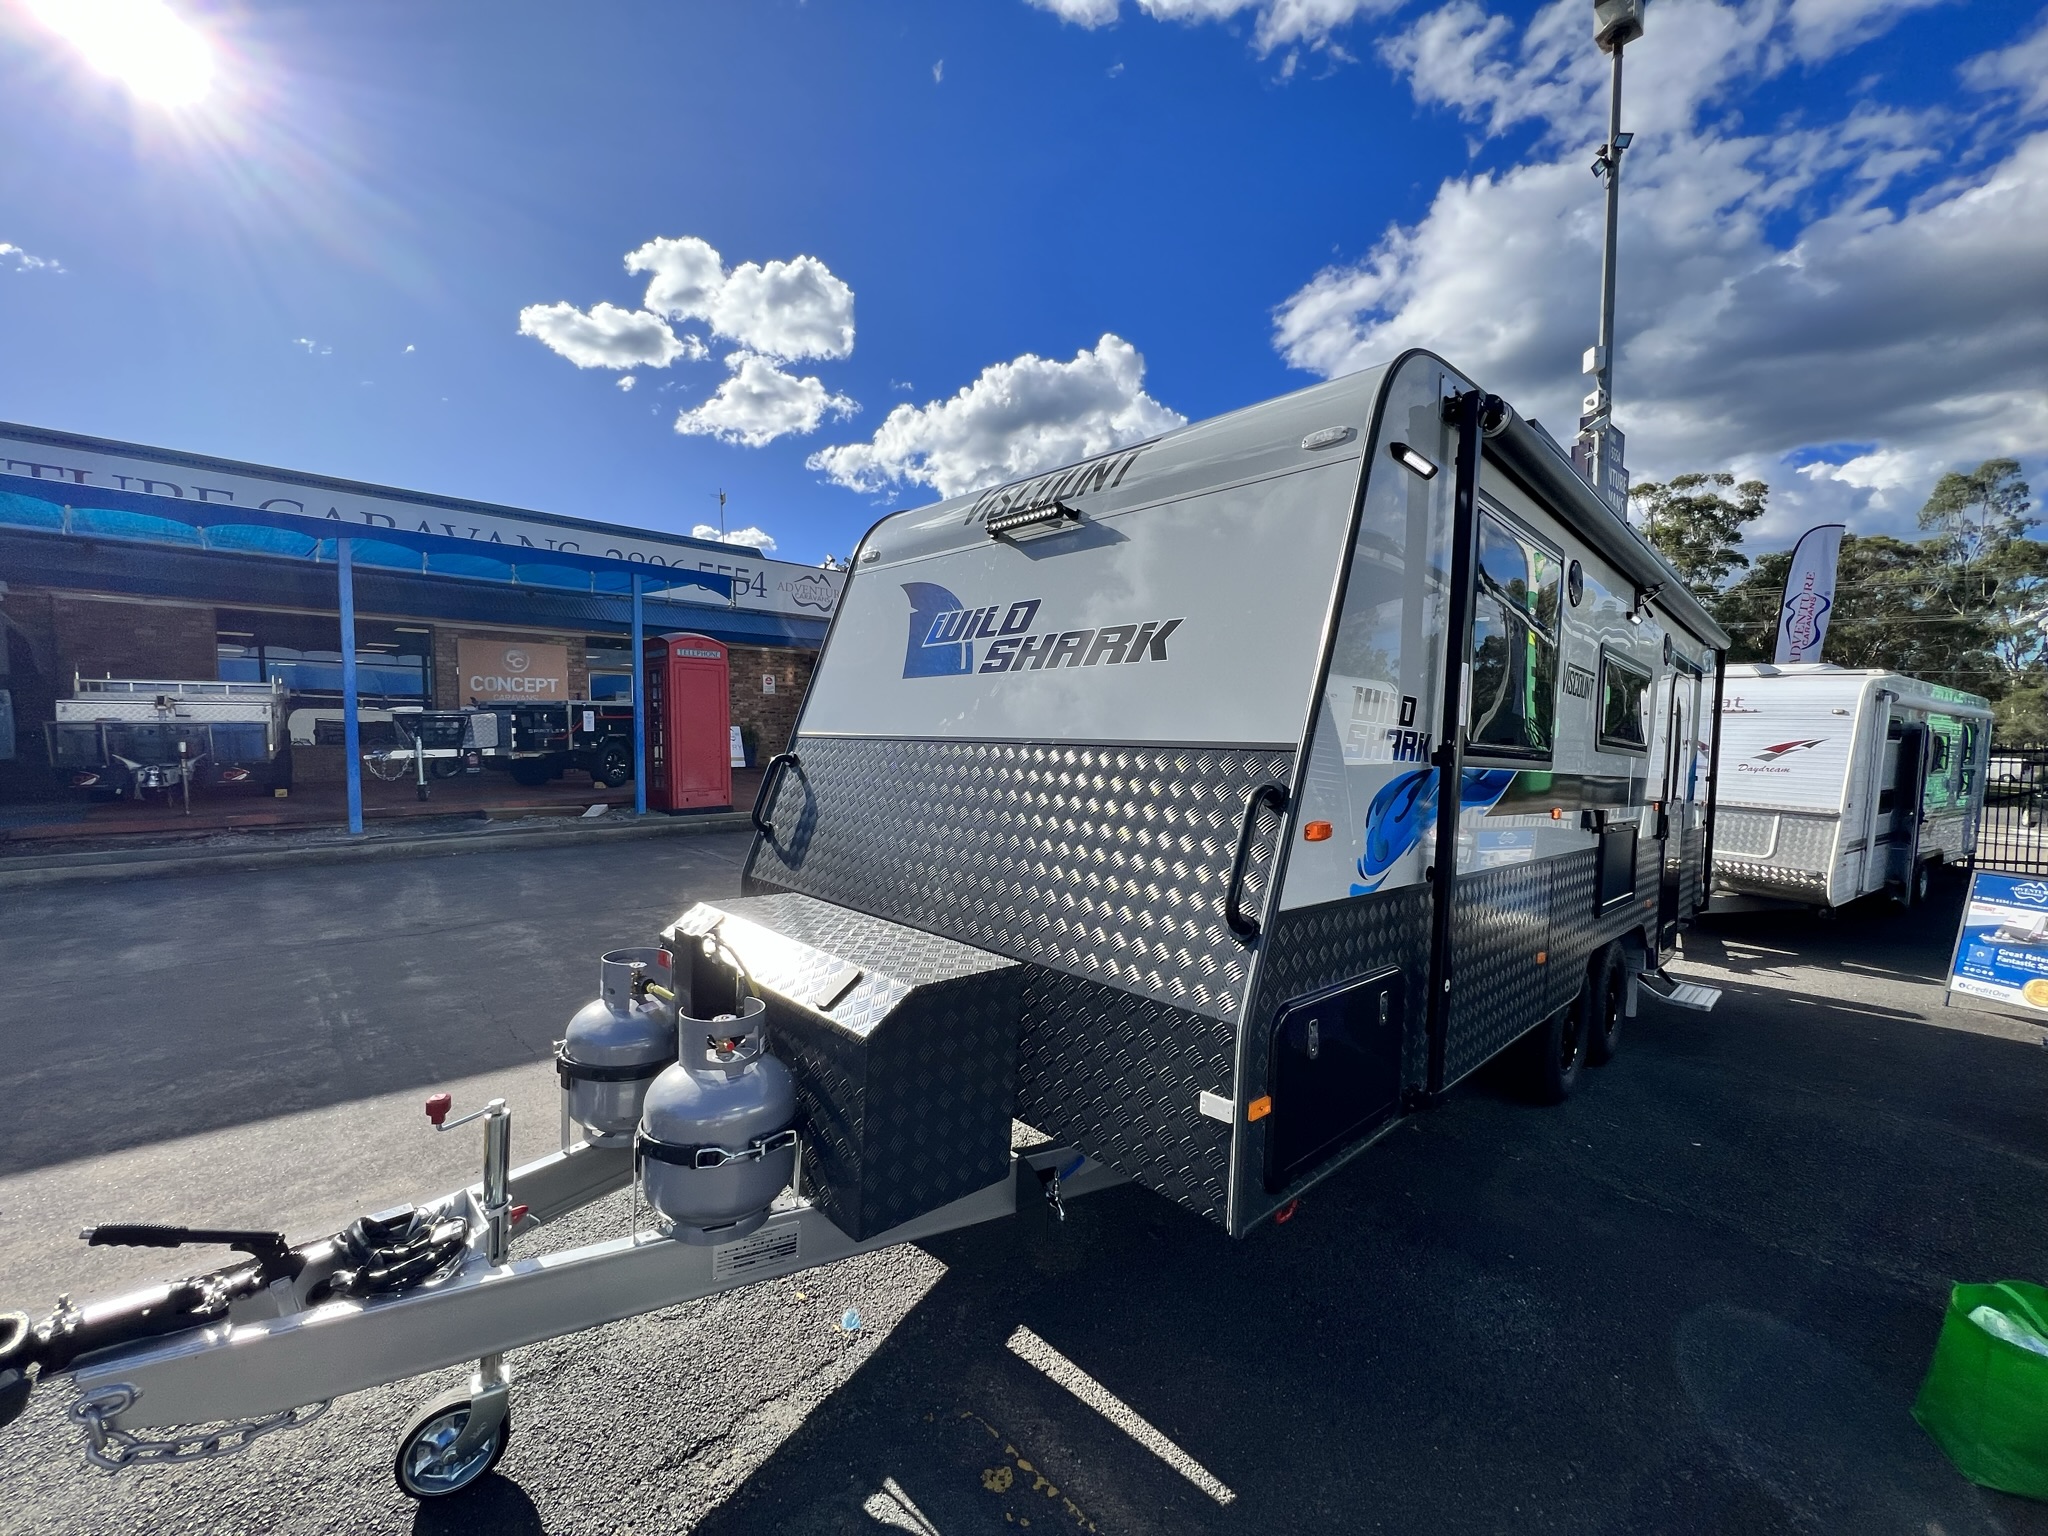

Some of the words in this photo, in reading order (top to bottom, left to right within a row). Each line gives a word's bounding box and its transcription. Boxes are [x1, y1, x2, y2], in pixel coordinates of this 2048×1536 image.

[964, 446, 1153, 525] VISCOUNT
[922, 598, 1042, 648] WILD
[1802, 596, 1816, 646] CARAVANS
[679, 649, 719, 658] TELEPHONE
[978, 617, 1186, 674] SHARK
[470, 676, 559, 693] CONCEPT
[1562, 661, 1595, 701] VISCOUNT
[1351, 686, 1417, 727] WILD
[1344, 724, 1432, 762] SHARK
[1738, 764, 1790, 773] Daydream
[1997, 955, 2036, 968] Fantastic
[1998, 948, 2023, 959] Great
[2025, 953, 2048, 964] Rate
[1966, 984, 2010, 998] CreditOne
